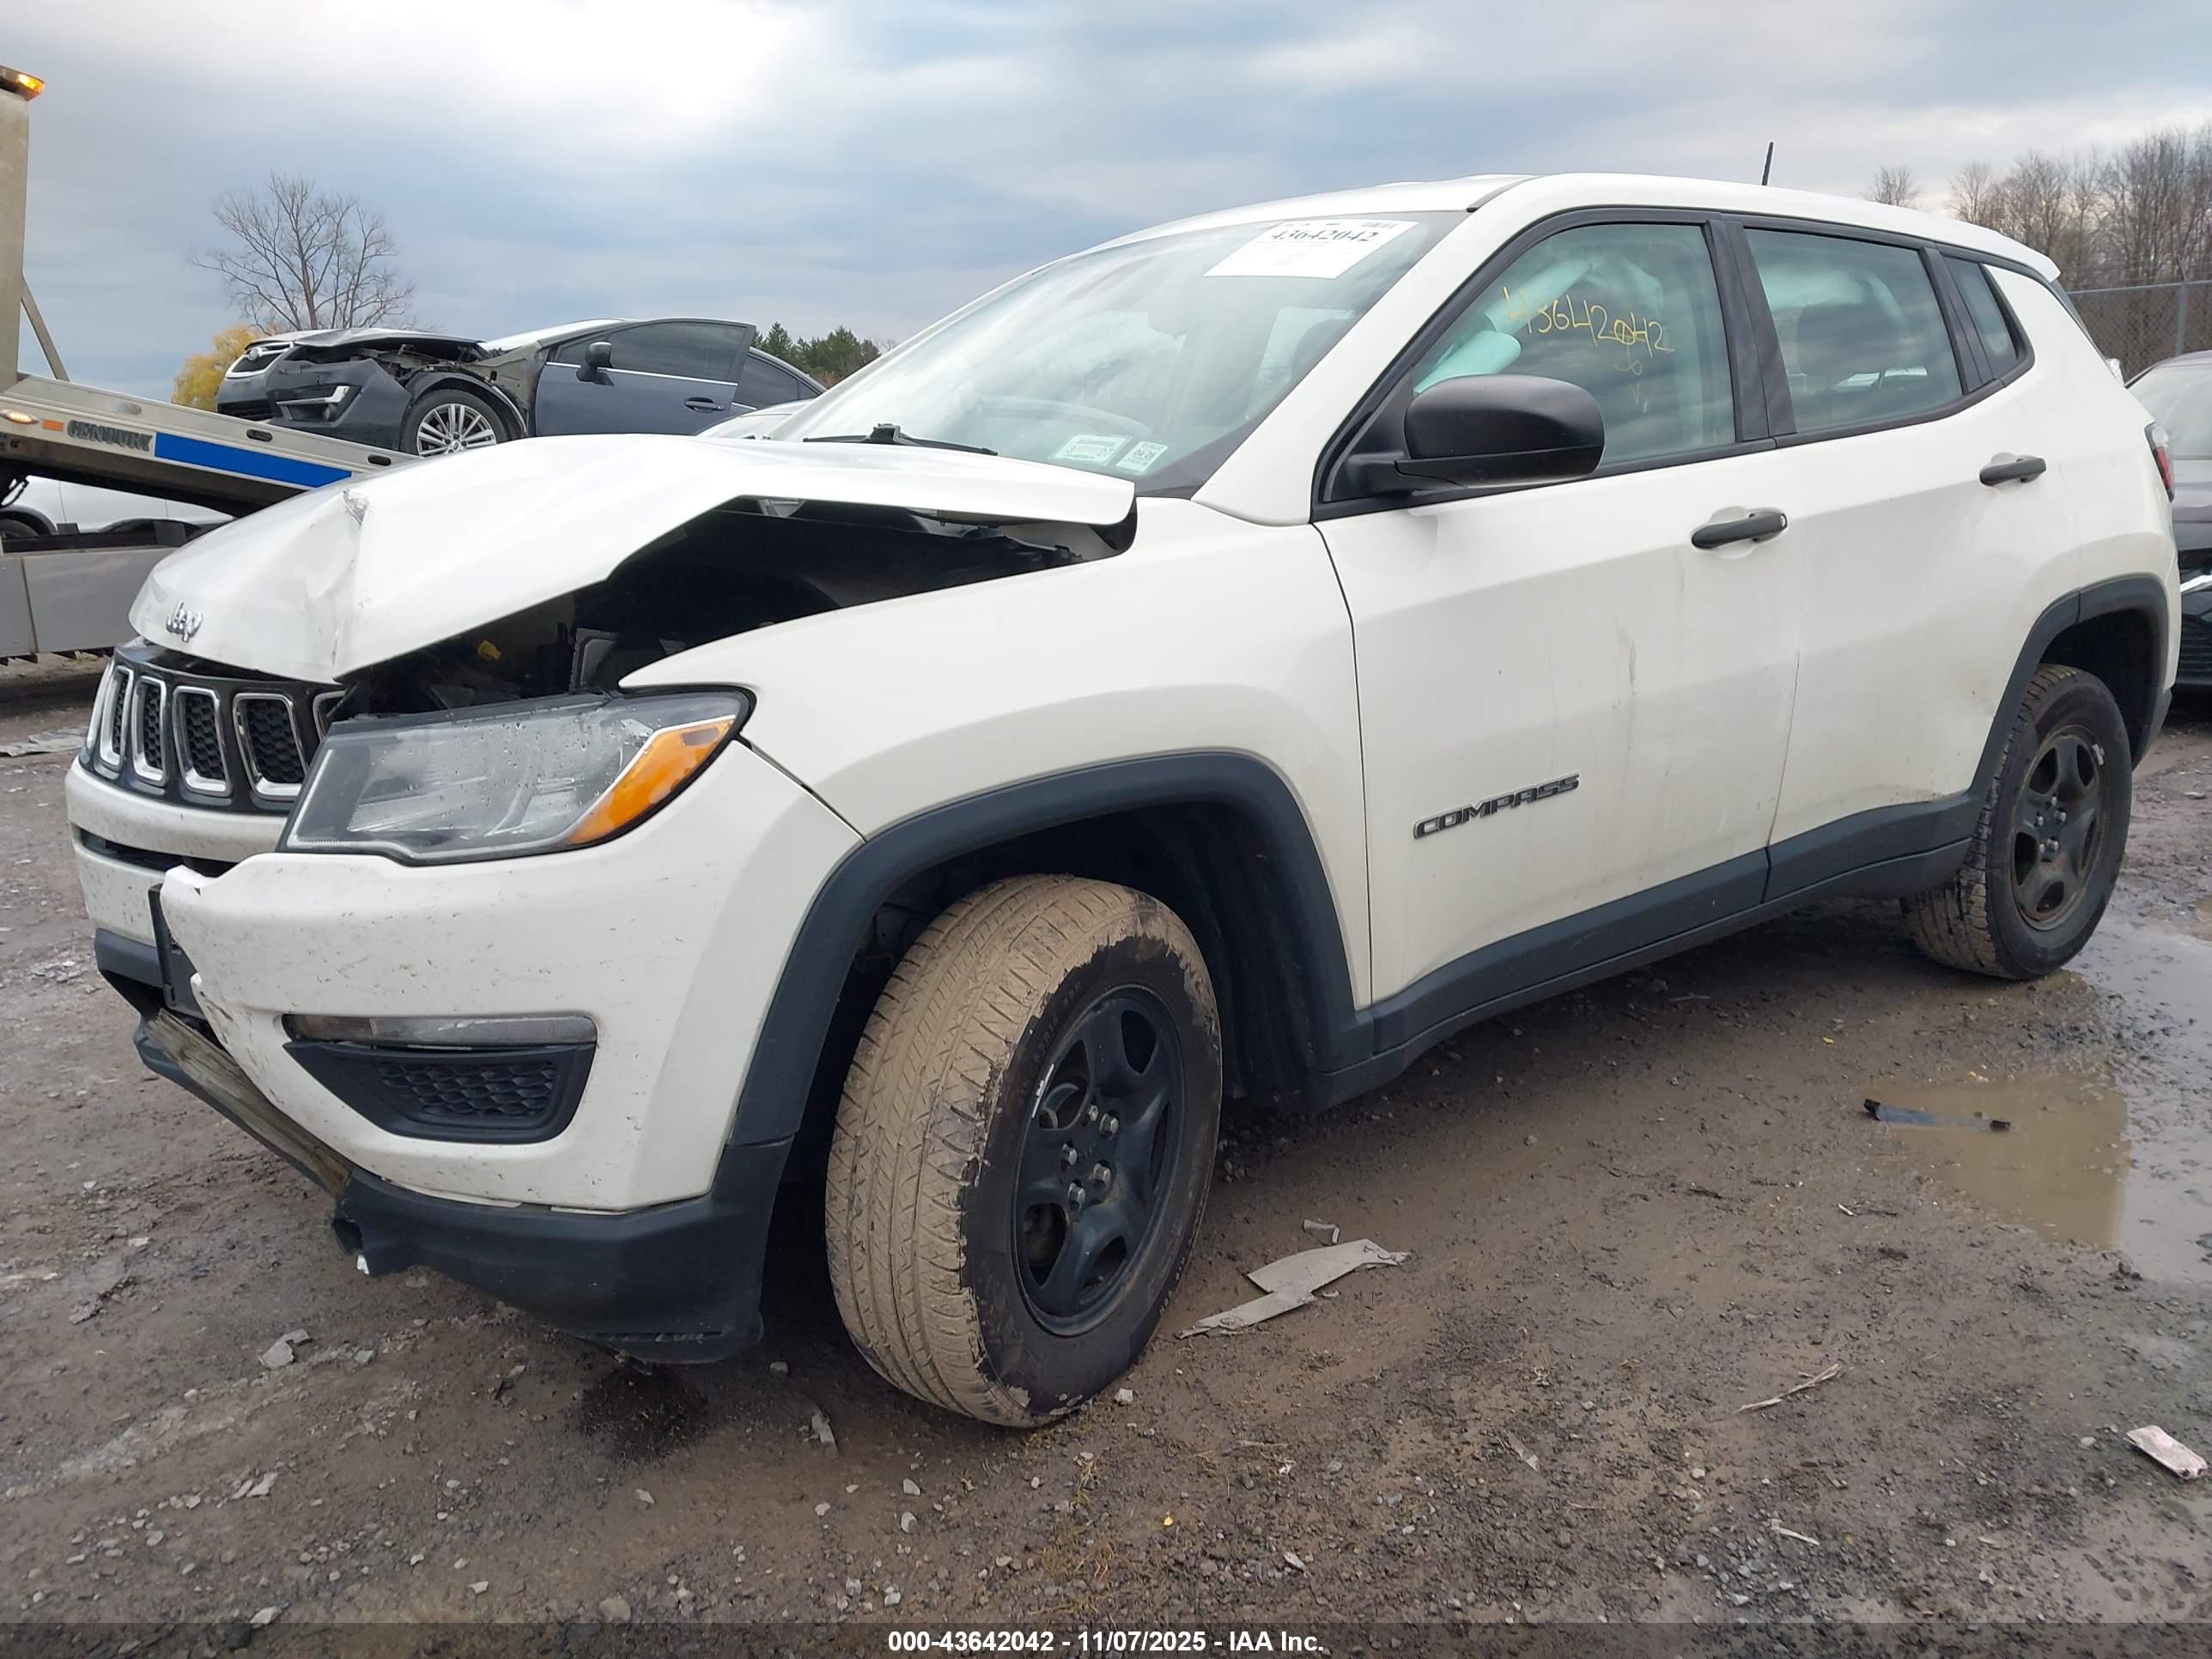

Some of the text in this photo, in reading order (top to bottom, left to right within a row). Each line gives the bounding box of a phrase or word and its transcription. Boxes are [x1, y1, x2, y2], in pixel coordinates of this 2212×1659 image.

[1269, 228, 1380, 242] 43642042
[1503, 286, 1676, 358] 43642042
[1413, 771, 1580, 839] COMPASS
